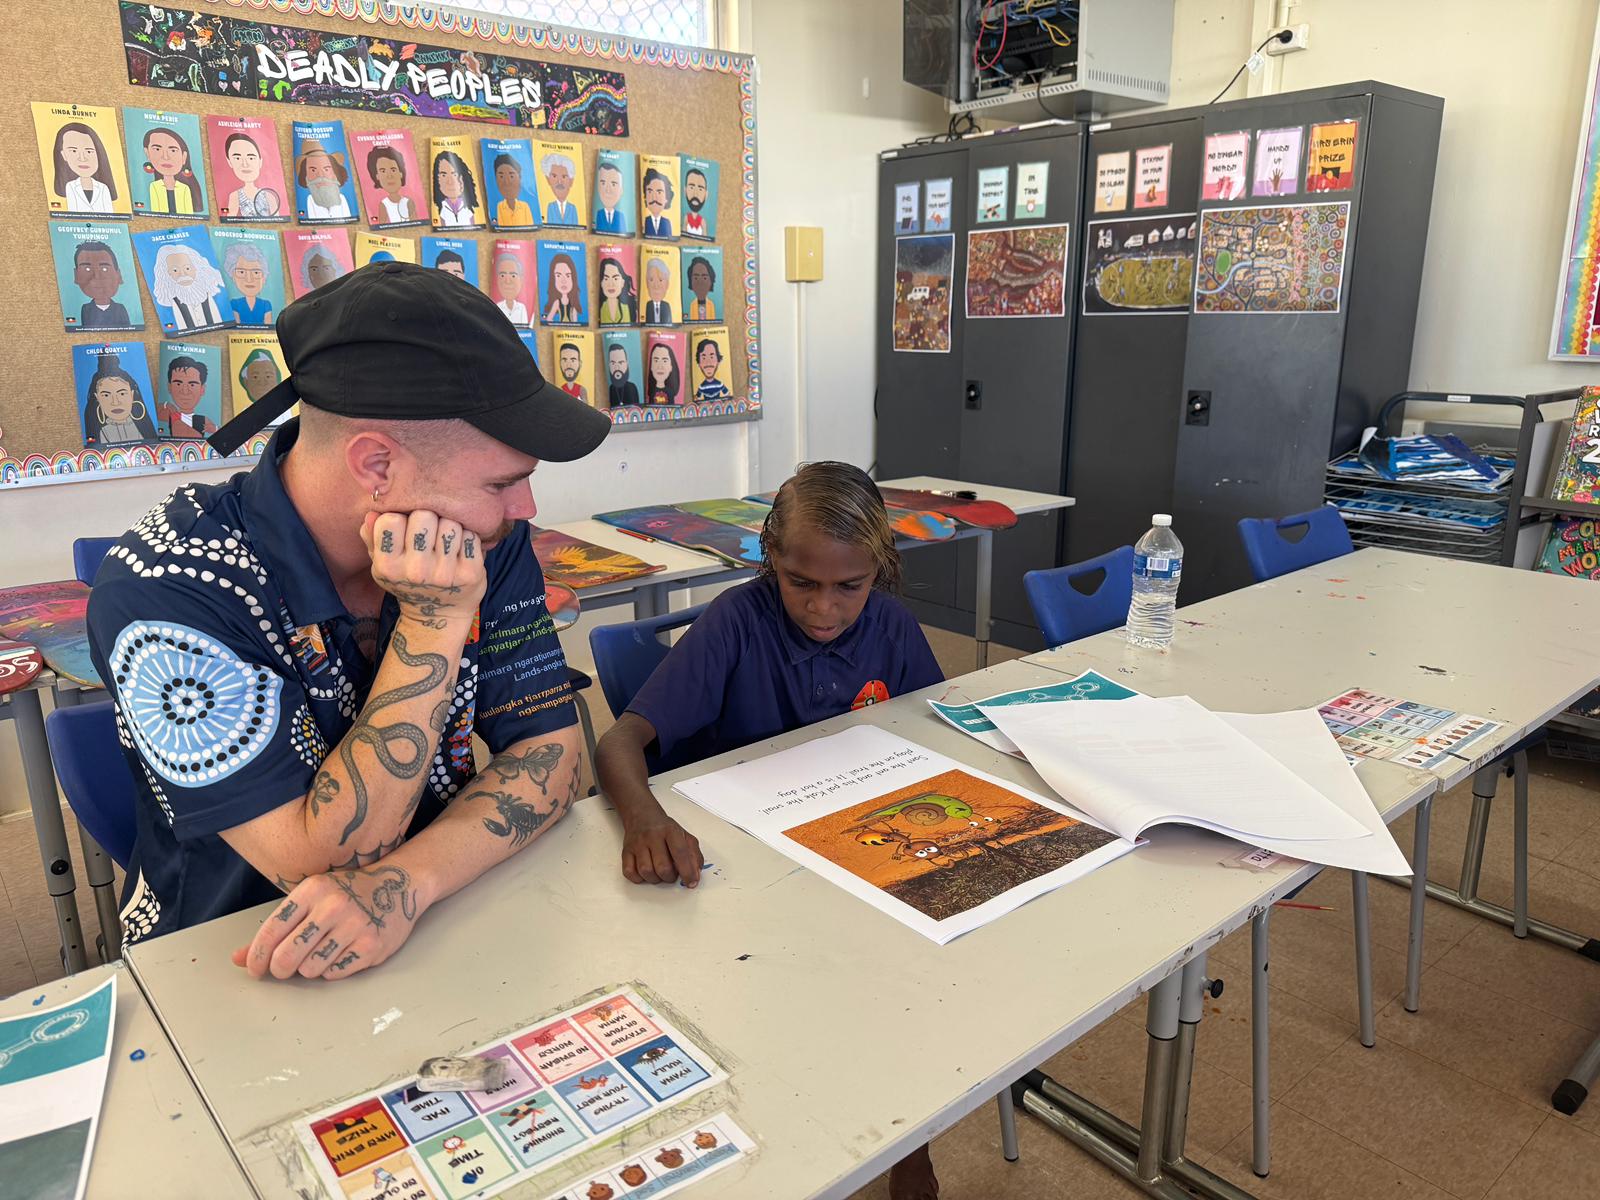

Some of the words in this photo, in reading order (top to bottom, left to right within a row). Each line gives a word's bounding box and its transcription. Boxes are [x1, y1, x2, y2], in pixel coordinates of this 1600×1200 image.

[255, 43, 400, 92] DEADLY
[406, 61, 543, 108] PEOPLES
[51, 108, 71, 116] LINDA
[72, 110, 97, 118] BURNEY
[143, 113, 160, 121] NOVA
[1332, 136, 1355, 147] ERIN
[1318, 153, 1346, 164] PRIZE
[57, 225, 89, 233] GEOFFREY
[89, 226, 122, 234] GURRUMUL
[72, 233, 109, 241] YUNUPINGU
[166, 231, 190, 240] CHARLES
[86, 347, 104, 355] CHLOE
[104, 346, 128, 354] QUAYLE
[893, 747, 914, 758] play
[875, 767, 889, 776] ant
[856, 773, 873, 783] and
[800, 783, 818, 793] hot
[826, 783, 841, 794] pal
[786, 797, 804, 805] the
[626, 1020, 638, 1028] ON
[603, 1024, 628, 1038] YOUR
[610, 1027, 647, 1046] STAYING
[538, 1039, 575, 1058] WORDS
[576, 1044, 590, 1057] NO
[603, 1083, 628, 1099] YOUR
[410, 1095, 444, 1113] TIME
[593, 1096, 630, 1116] TRYING
[337, 1123, 379, 1146] PRIZE
[367, 1129, 397, 1148] MRS
[331, 1143, 366, 1164] ERIN
[448, 1148, 485, 1169] TIME
[402, 1177, 417, 1190] SO
